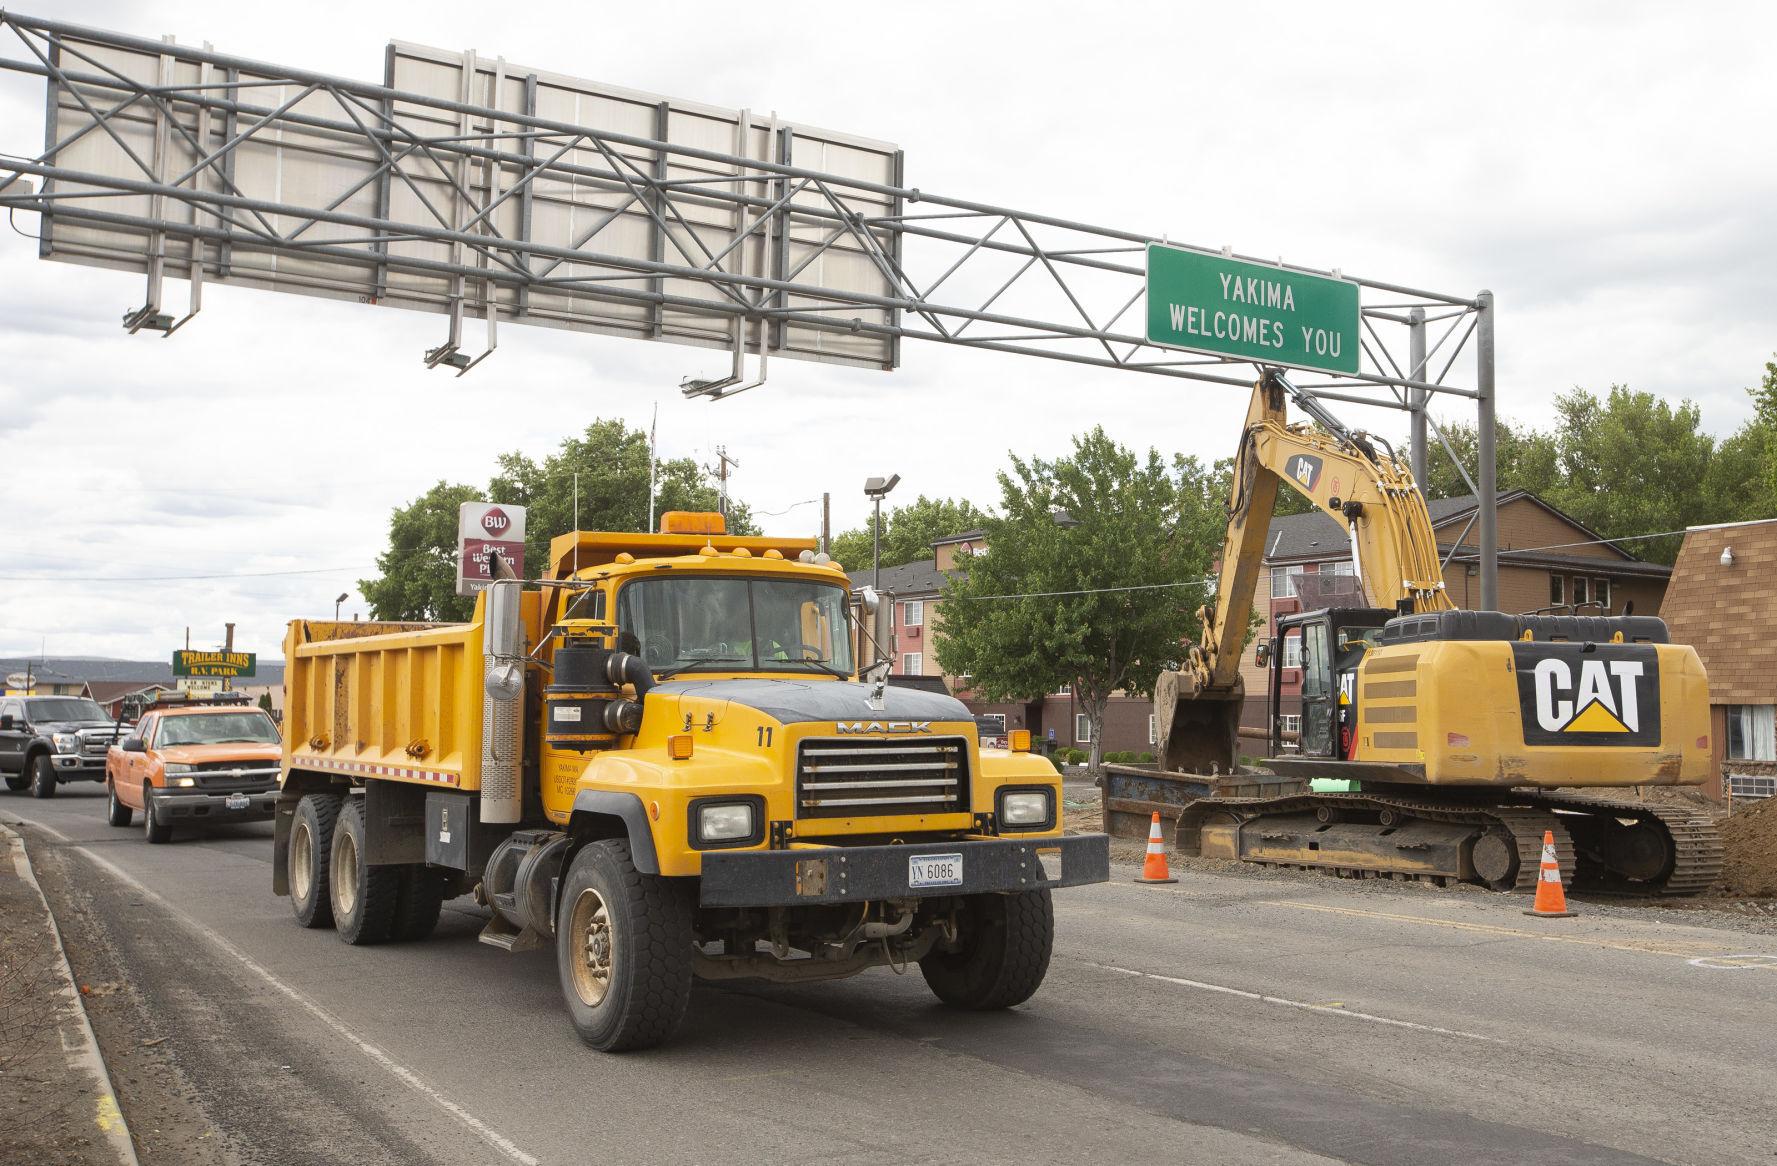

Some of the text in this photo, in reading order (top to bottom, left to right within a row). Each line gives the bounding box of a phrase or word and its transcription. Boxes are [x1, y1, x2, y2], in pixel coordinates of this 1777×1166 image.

[1219, 272, 1295, 312] YAKIMA
[1169, 303, 1341, 358] WELCOMES YOU
[1296, 457, 1313, 488] CAT
[484, 515, 507, 529] BW
[483, 544, 506, 554] Best
[472, 553, 515, 565] Wern
[181, 651, 249, 667] TRAILER INNS
[211, 667, 238, 676] PARK
[1534, 658, 1644, 733] CAT
[836, 721, 932, 734] MACK
[757, 726, 773, 748] 11
[927, 863, 954, 879] 6086
